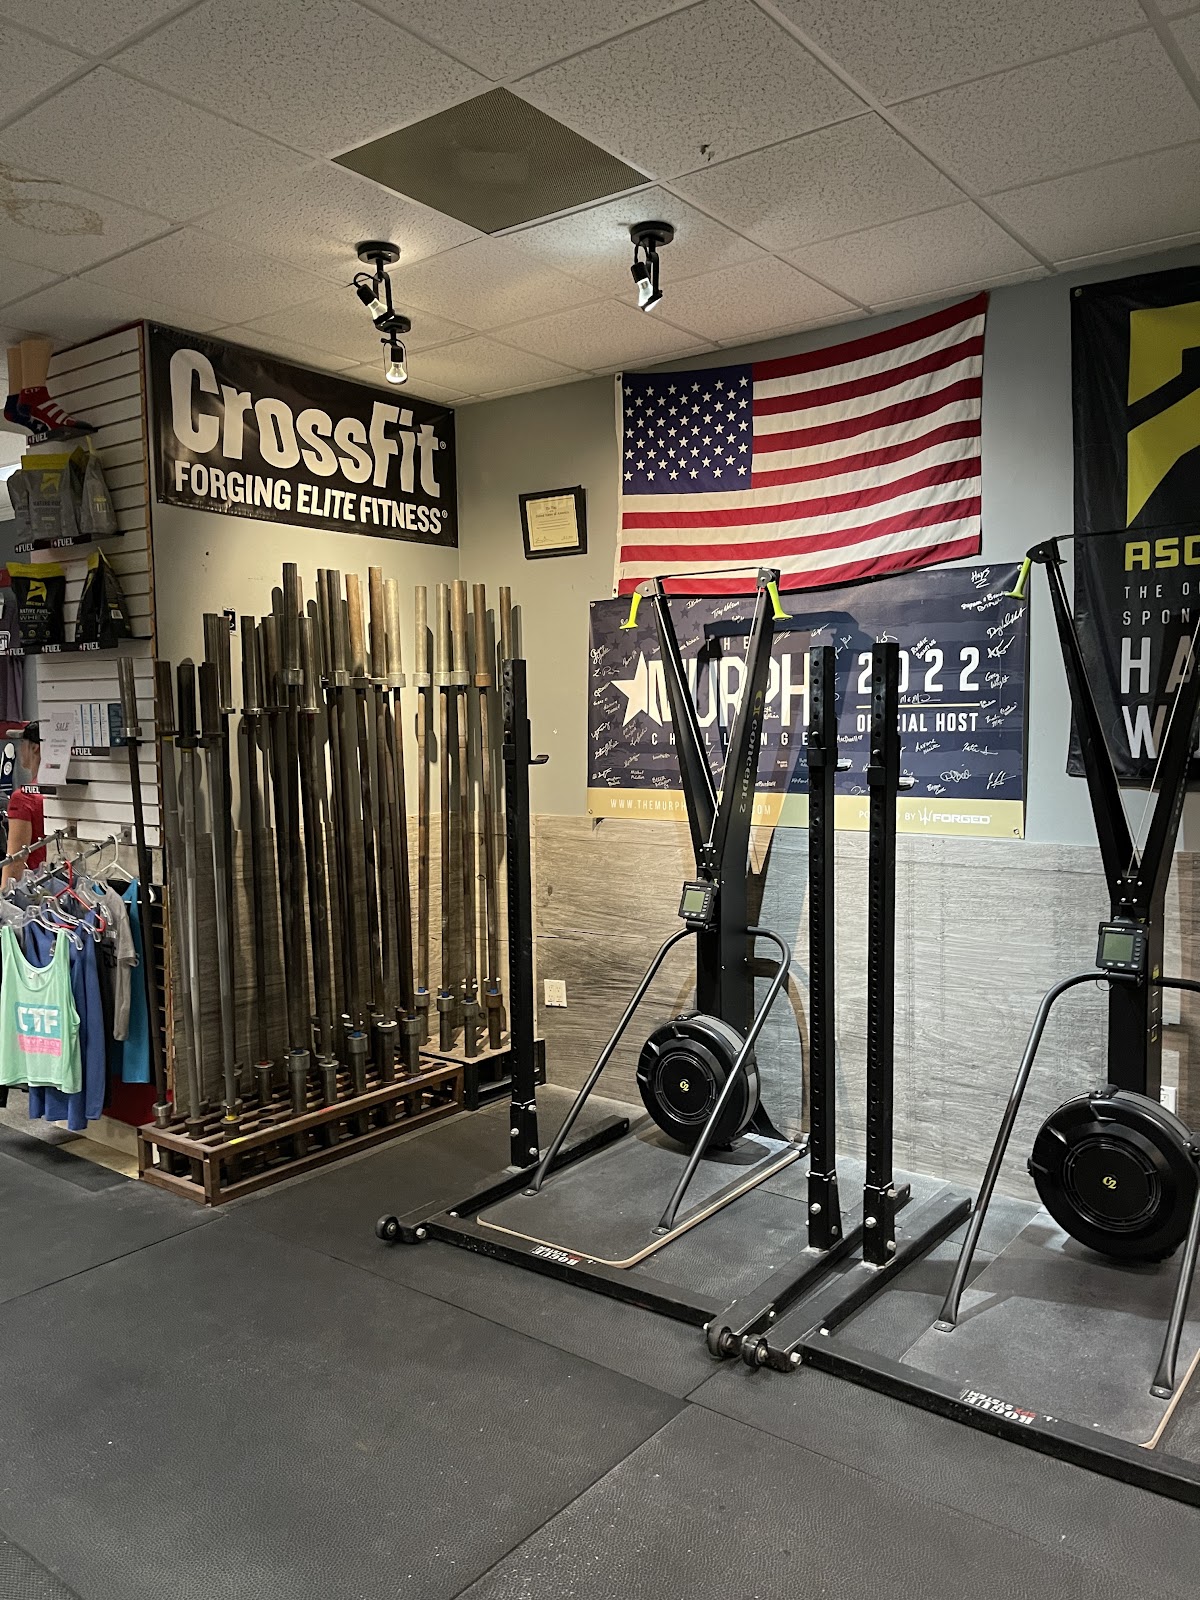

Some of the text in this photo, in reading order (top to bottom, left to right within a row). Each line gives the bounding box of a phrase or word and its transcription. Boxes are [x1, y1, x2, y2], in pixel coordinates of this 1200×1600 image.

[32, 432, 48, 443] FUEL
[174, 460, 291, 511] FORGING
[297, 483, 356, 521] ELITE
[19, 543, 34, 552] FUEL
[57, 537, 74, 547] FUEL
[1124, 584, 1163, 599] THE
[46, 644, 61, 653] FUEL
[83, 642, 99, 651] FUEL
[858, 646, 980, 694] 2022
[936, 713, 978, 732] HOST
[75, 747, 92, 755] FUEL
[25, 785, 40, 794] FUEL
[932, 813, 990, 824] FORGED
[18, 1006, 58, 1034] CTF
[1102, 1176, 1117, 1189] C2
[963, 1396, 1035, 1425] ROGUE
